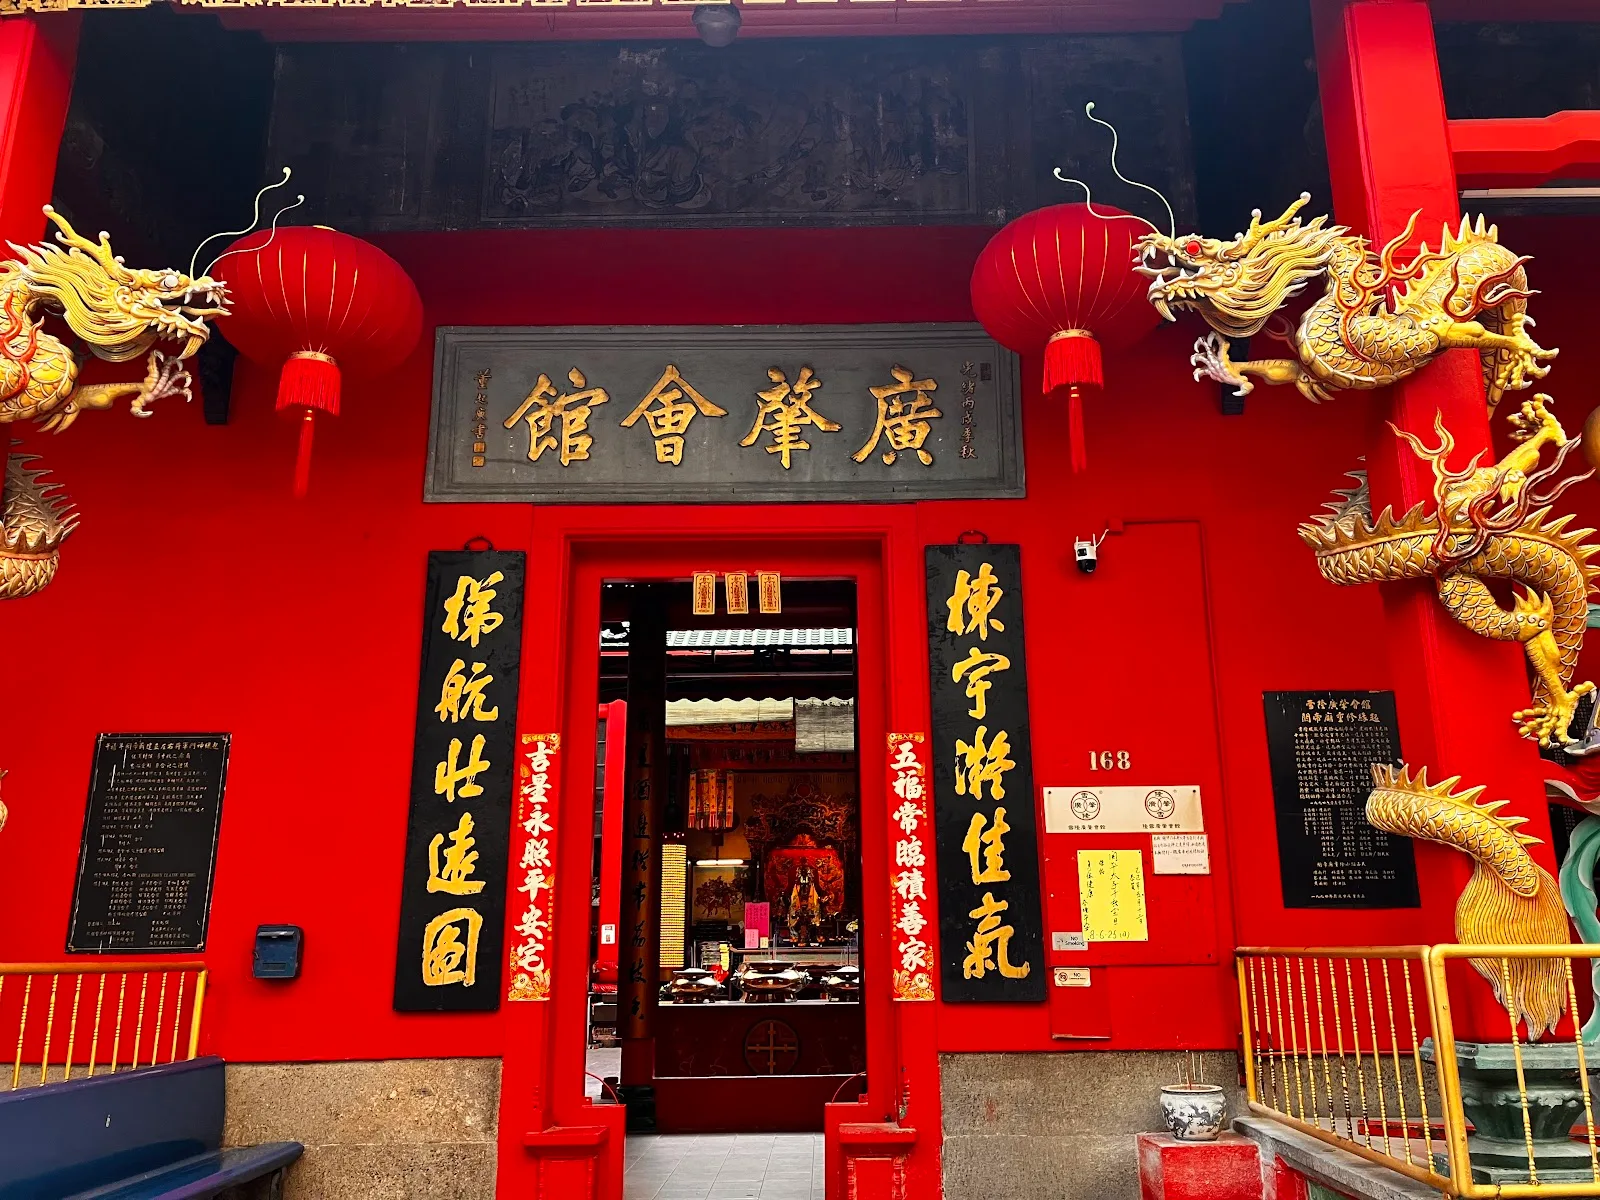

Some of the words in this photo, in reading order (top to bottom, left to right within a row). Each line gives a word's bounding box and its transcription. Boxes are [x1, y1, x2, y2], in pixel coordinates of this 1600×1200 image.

[502, 363, 943, 470] 廣肇會館
[1089, 751, 1131, 770] 168
[890, 741, 928, 971] 五福常臨積善家
